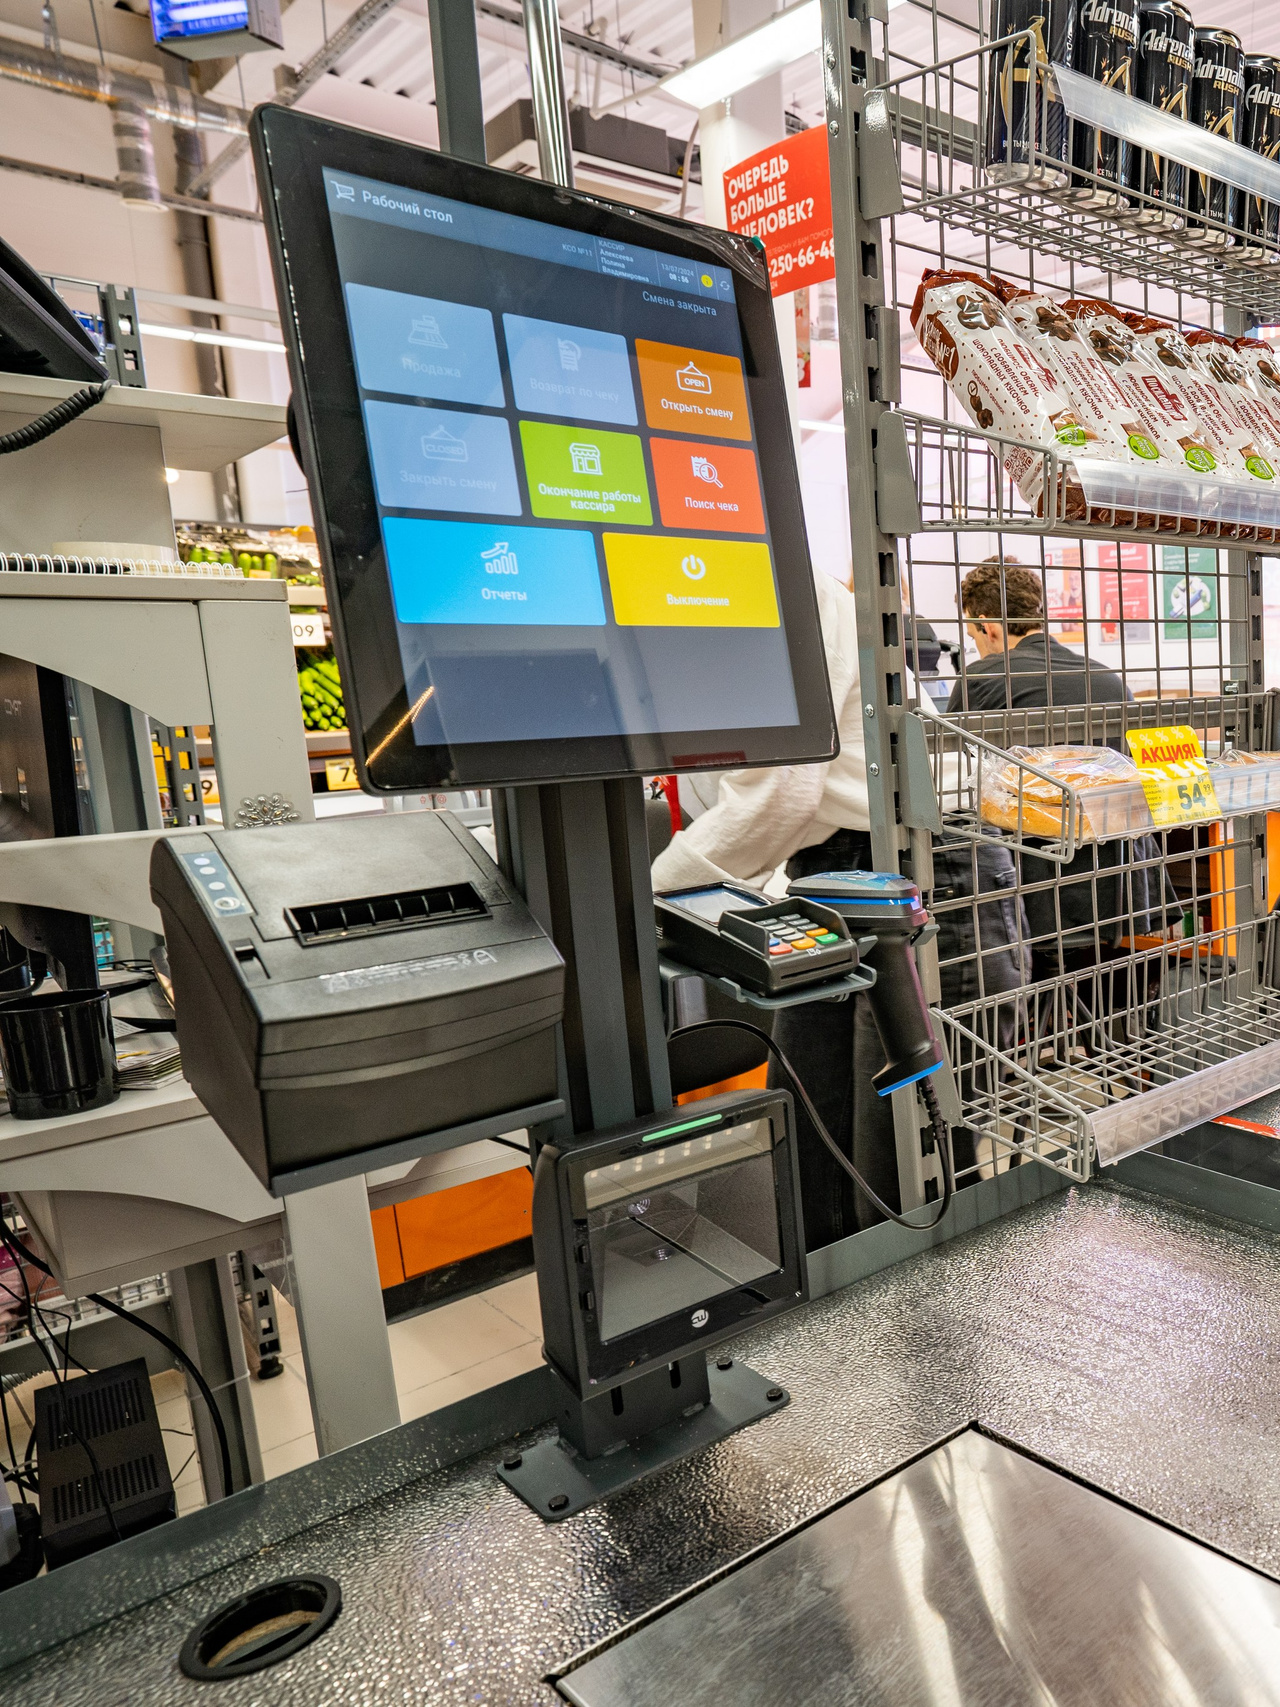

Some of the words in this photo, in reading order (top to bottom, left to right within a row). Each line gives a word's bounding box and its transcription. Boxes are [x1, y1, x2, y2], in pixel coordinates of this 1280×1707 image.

[1109, 26, 1136, 44] RUSH
[1167, 54, 1192, 72] RUSH
[1213, 79, 1240, 96] RUSH
[728, 154, 789, 200] ОЧЕРЕДЬ
[362, 190, 420, 216] Рабочий
[423, 208, 453, 224] стол
[730, 181, 787, 226] БОЛЬШЕ
[741, 197, 814, 239] ЧЕЛОВЕК?
[598, 239, 626, 251] КАССИР
[600, 248, 634, 263] Алексеева
[601, 257, 626, 269] Полина
[661, 262, 695, 277] 13/07/2024
[642, 290, 675, 308] Смена
[676, 300, 717, 316] закрыта
[401, 357, 461, 378] Продажа
[972, 338, 1007, 384] ШОКОЛАДНЫХ
[1003, 381, 1031, 415] КУСОЧКОВ
[994, 352, 1029, 396] ДОБАВЛЕНИЕМ
[529, 377, 576, 396] Возврат
[579, 386, 593, 399] по
[595, 388, 620, 403] чеку
[684, 377, 705, 388] OPEN
[661, 398, 703, 415] Открыть
[705, 407, 734, 421] смену
[1080, 387, 1104, 420] КУСОЧКОВ
[425, 443, 464, 455] CLOSED
[399, 470, 456, 488] Закрыть
[459, 475, 497, 491] смену
[538, 482, 600, 500] Окончание
[602, 489, 641, 504] работы
[570, 499, 616, 513] кассира
[684, 496, 715, 511] Поиск
[717, 500, 739, 512] чека
[481, 587, 527, 602] Отчеты
[666, 593, 730, 607] Выключение
[1141, 743, 1198, 764] АКЦИЯ!
[1177, 783, 1207, 810] 54
